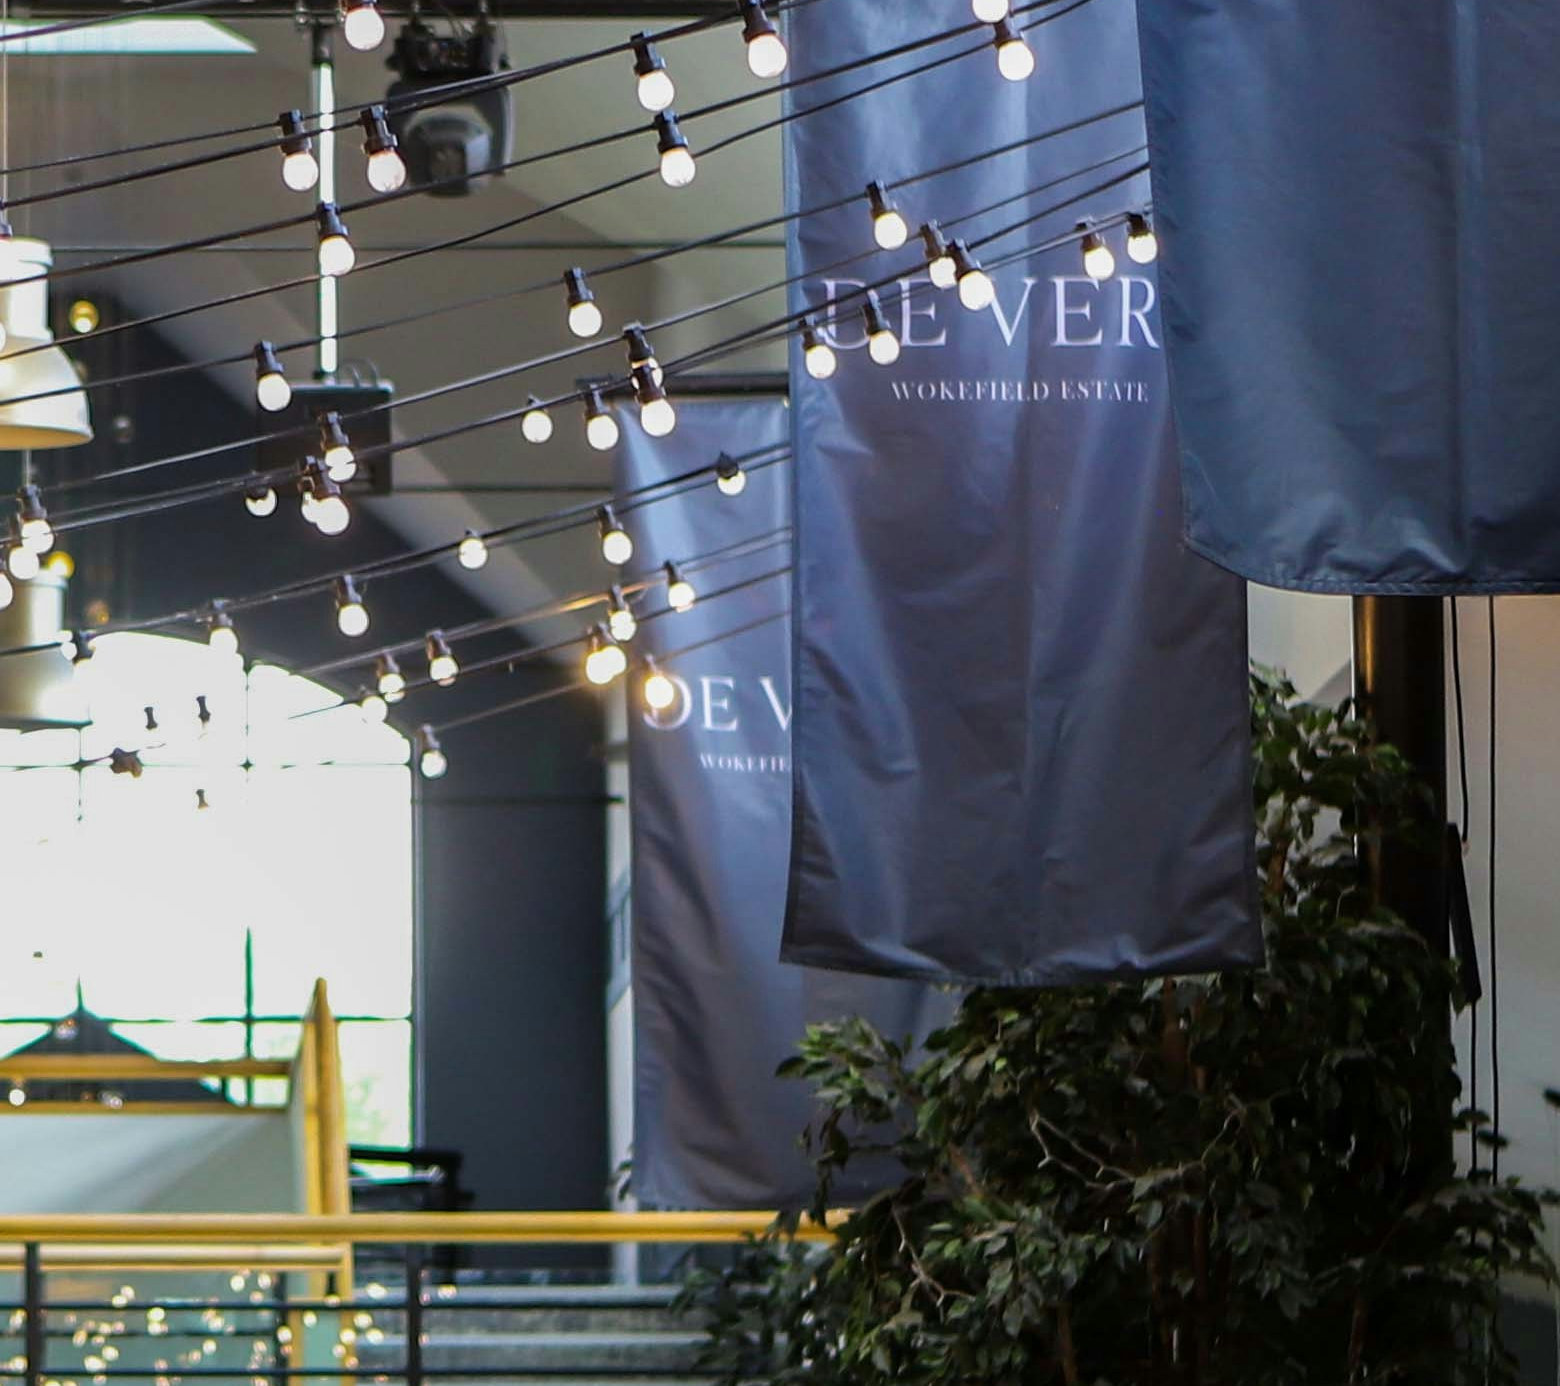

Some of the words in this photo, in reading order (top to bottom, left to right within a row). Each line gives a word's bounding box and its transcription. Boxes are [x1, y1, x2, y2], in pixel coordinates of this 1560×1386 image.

[820, 277, 948, 351] DE
[978, 276, 1161, 350] VER
[890, 380, 1049, 403] WOKEFIELD
[1061, 380, 1149, 404] ESTATE
